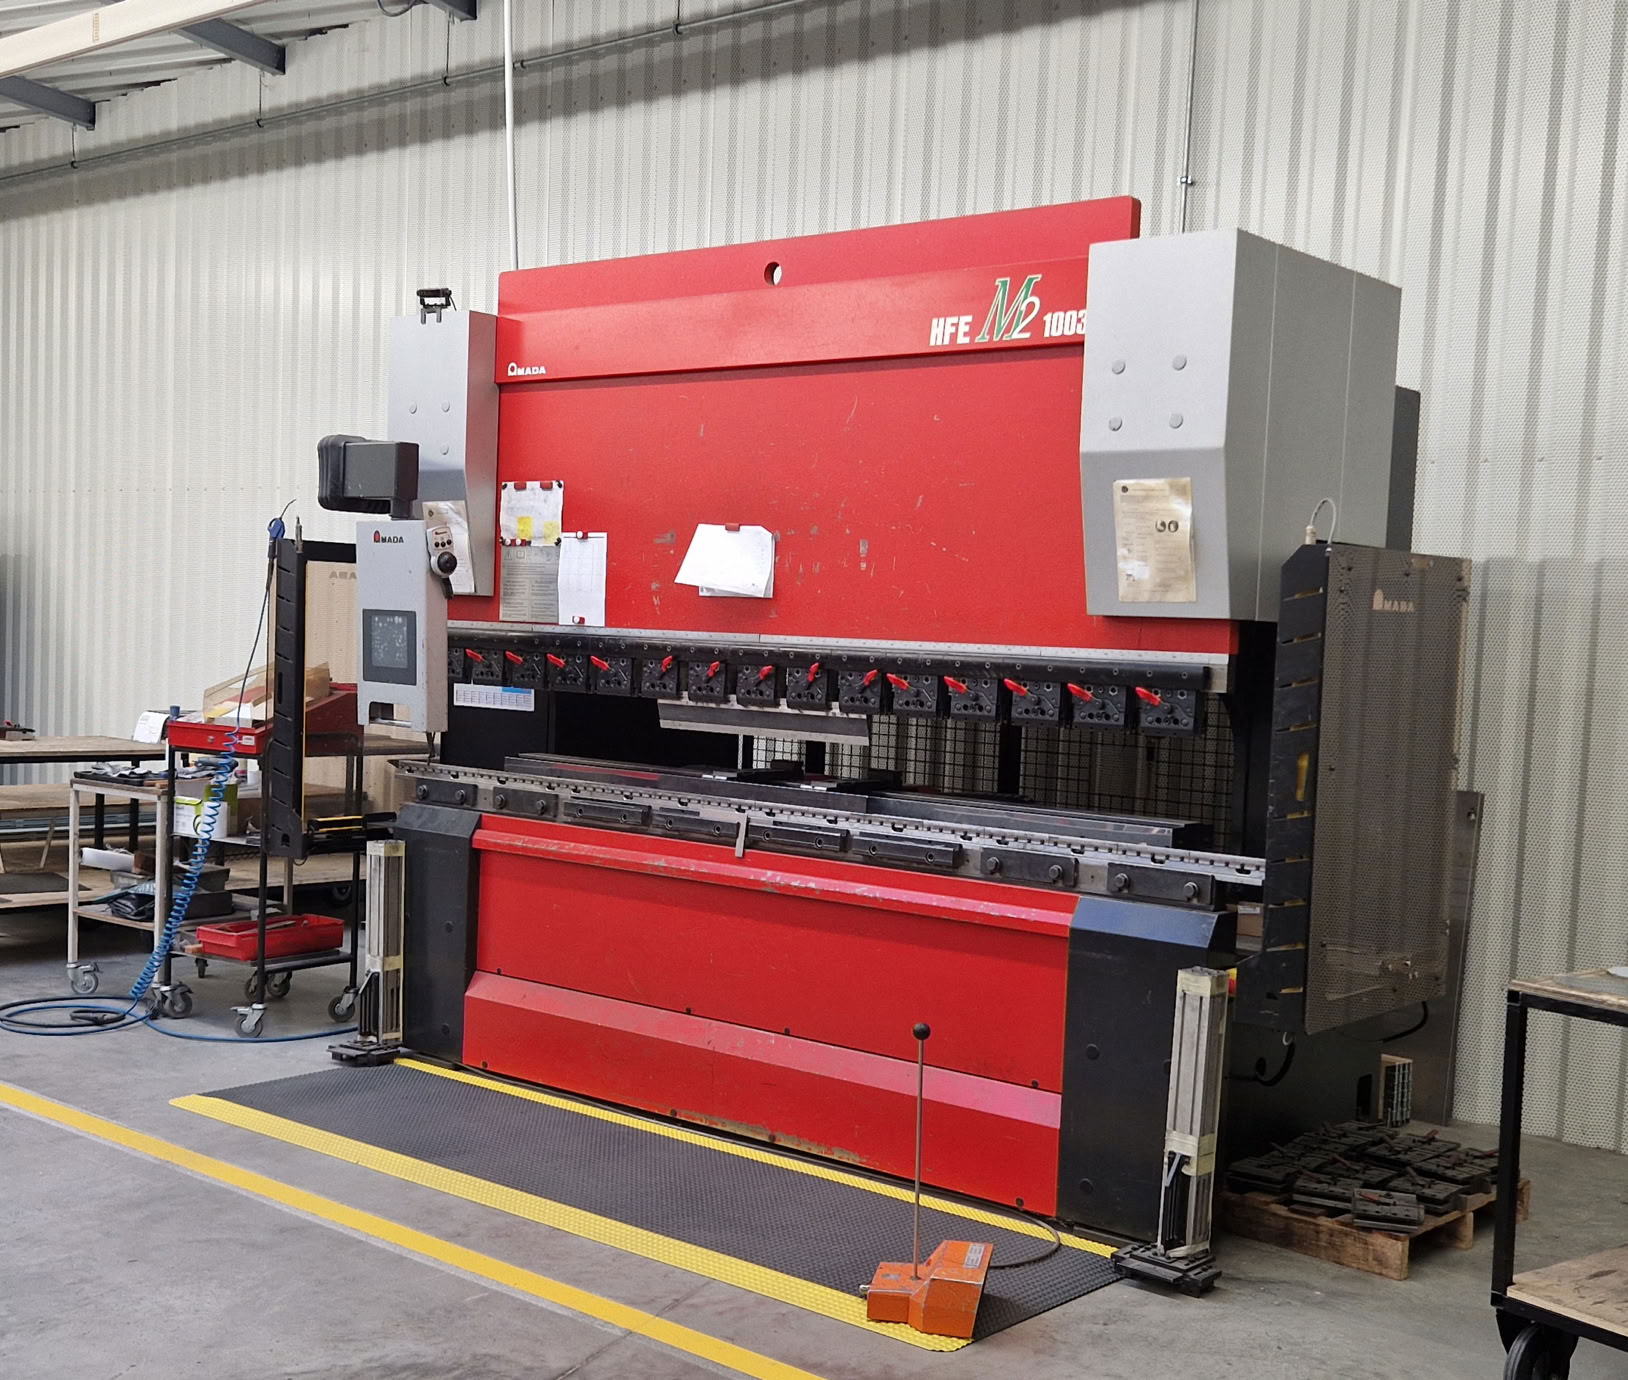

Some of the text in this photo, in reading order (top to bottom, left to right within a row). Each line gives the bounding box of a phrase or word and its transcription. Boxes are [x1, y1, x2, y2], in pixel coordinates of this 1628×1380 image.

[930, 316, 973, 346] HFE
[1043, 310, 1087, 337] 1003
[508, 362, 546, 376] AMADA
[374, 530, 404, 543] AMADA
